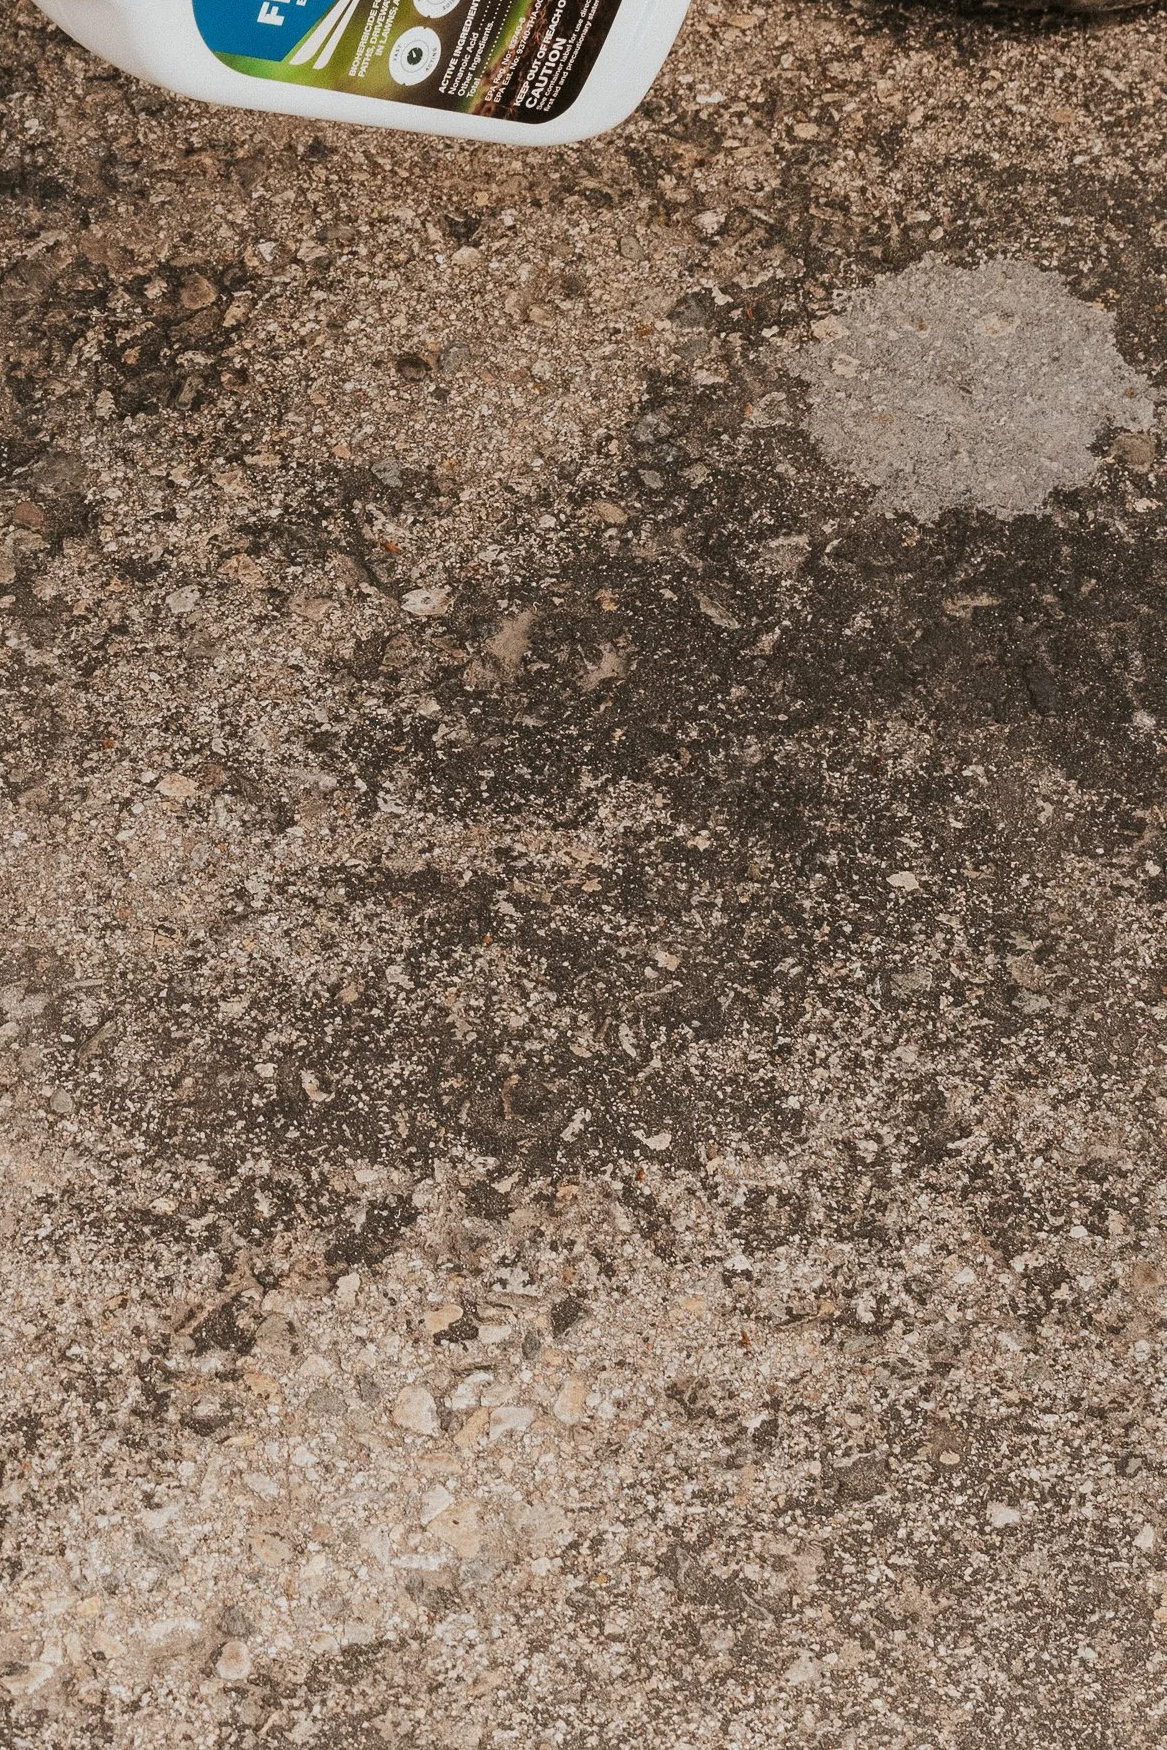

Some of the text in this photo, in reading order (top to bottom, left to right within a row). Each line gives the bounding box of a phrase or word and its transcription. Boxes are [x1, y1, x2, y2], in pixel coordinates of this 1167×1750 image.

[347, 9, 377, 76] BIOHERBICIDE
[374, 45, 384, 55] IN
[378, 6, 398, 43] LAWNS;
[357, 45, 375, 77] PATHS,
[437, 57, 458, 93] ACTIVE
[447, 53, 471, 94] Nonanoic
[465, 32, 479, 52] Acid
[484, 85, 496, 101] EPA
[493, 66, 507, 84] Reg.
[501, 50, 512, 65] No:
[493, 86, 506, 102] EPA
[501, 70, 513, 85] Est.
[509, 55, 520, 69] No:
[513, 80, 532, 106] KEEP
[525, 58, 541, 81] OUT
[535, 43, 548, 59] OF
[542, 8, 563, 43] REACH
[524, 36, 567, 109] CAUTION
[536, 96, 547, 110] See
[542, 63, 564, 96] container
[560, 44, 573, 62] label
[567, 33, 577, 43] for
[574, 18, 584, 31] use
[543, 97, 555, 112] first
[550, 85, 561, 97] aid
[557, 71, 568, 85] and
[564, 21, 592, 70] precautionary
[457, 71, 473, 96] Other
